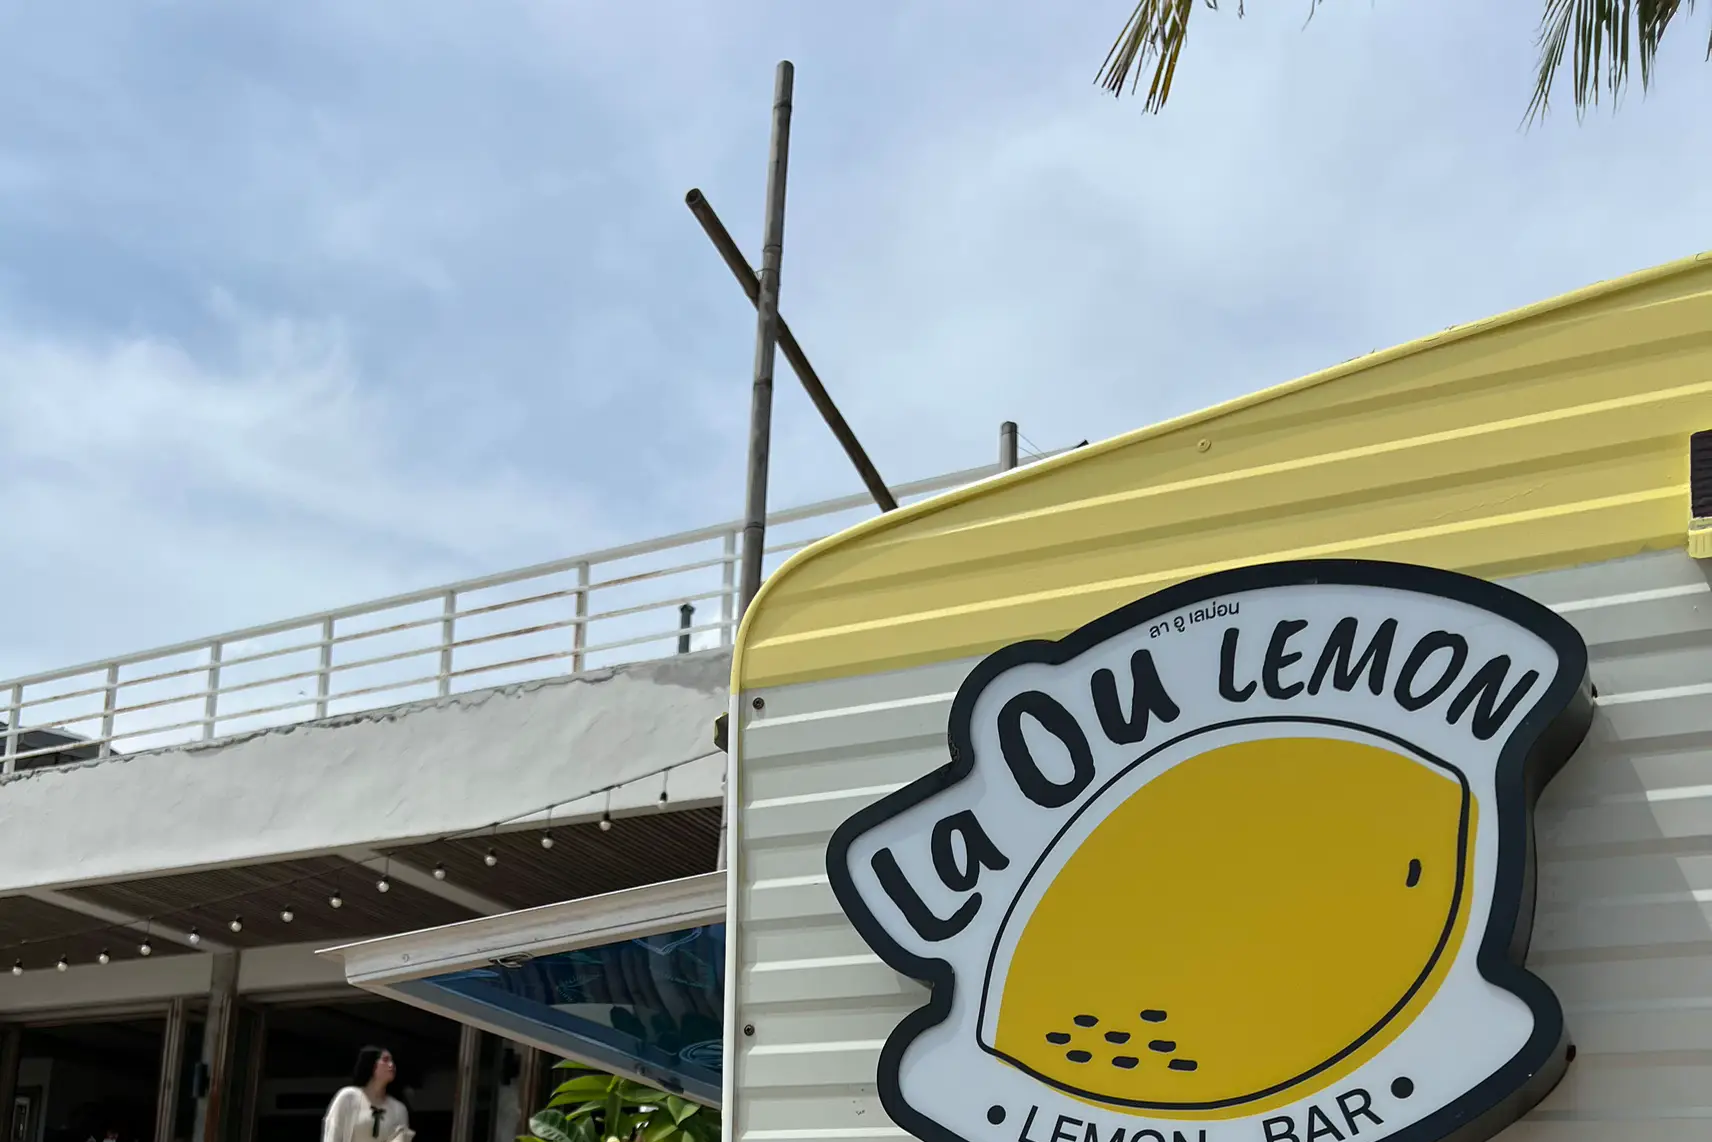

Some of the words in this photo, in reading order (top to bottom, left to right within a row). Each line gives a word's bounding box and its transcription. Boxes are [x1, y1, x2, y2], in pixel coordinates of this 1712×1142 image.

[1149, 621, 1170, 639] ลา
[1189, 601, 1240, 625] เลม่อน
[870, 809, 1011, 943] La
[1218, 616, 1540, 741] LEMON
